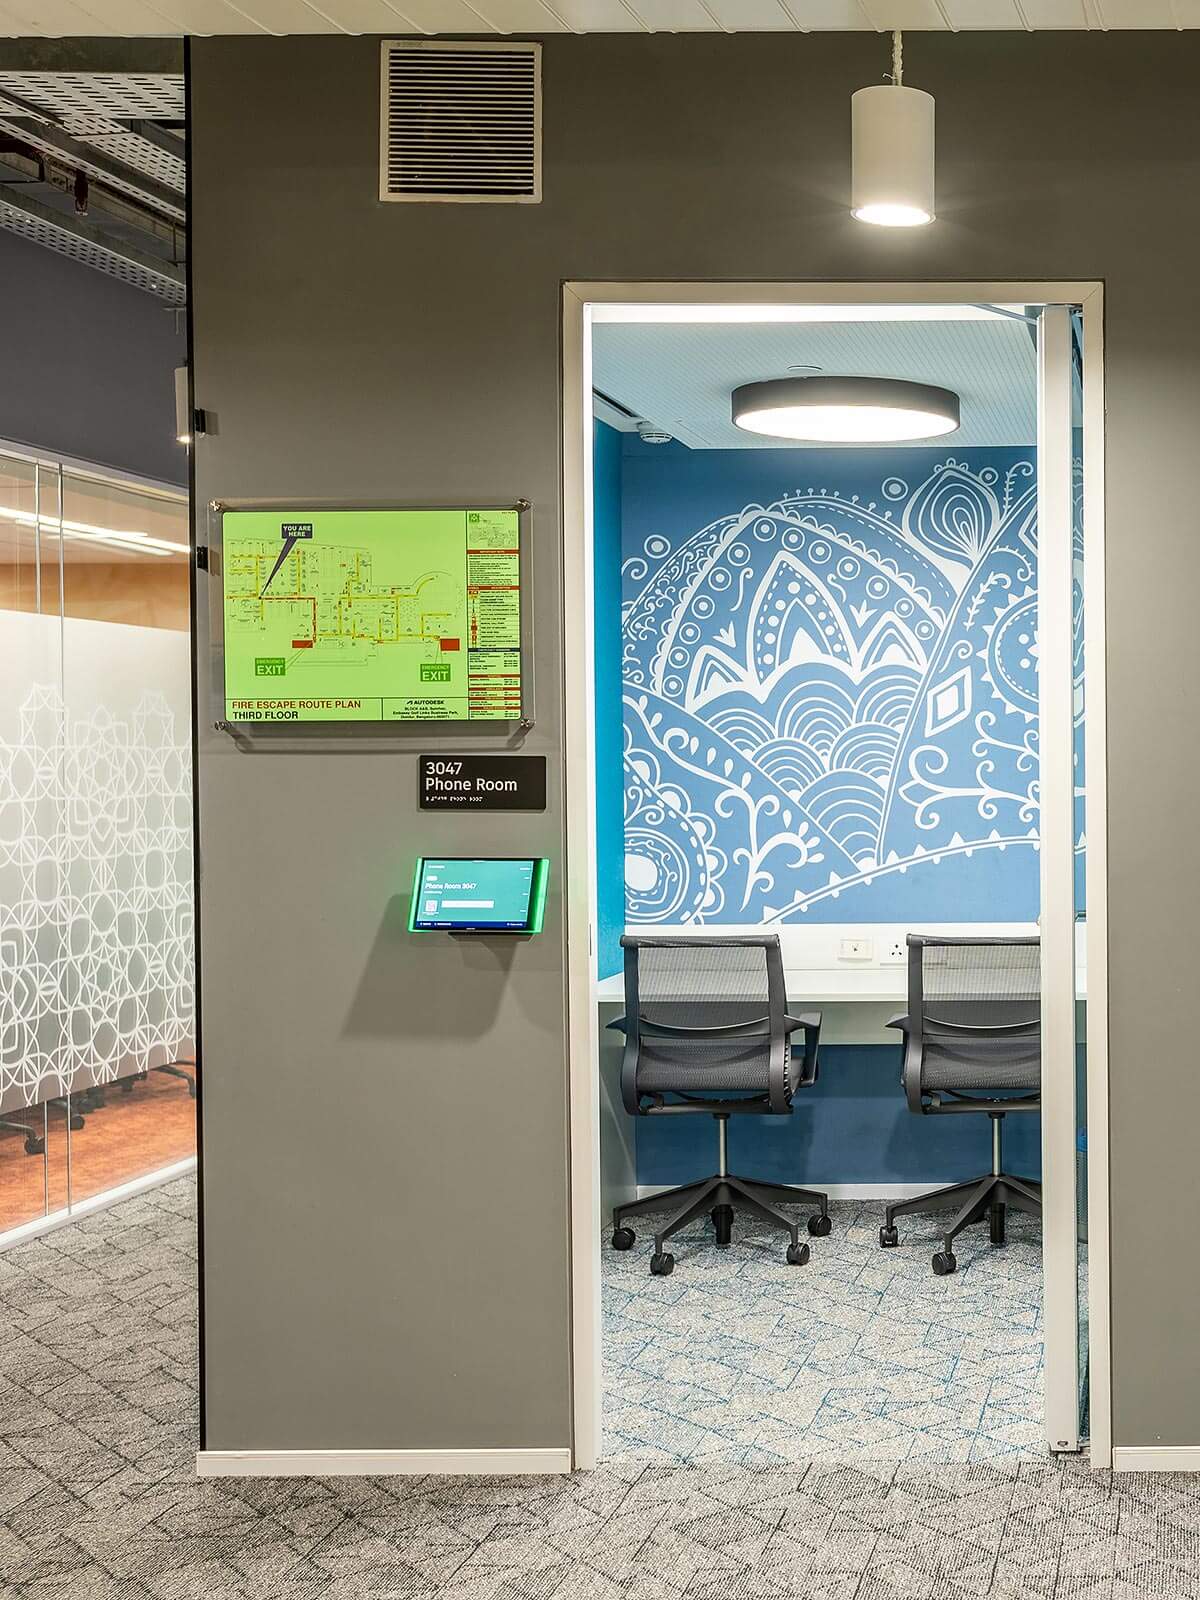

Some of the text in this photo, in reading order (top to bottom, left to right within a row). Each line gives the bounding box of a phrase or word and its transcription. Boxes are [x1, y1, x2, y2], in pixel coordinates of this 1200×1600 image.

[257, 665, 283, 674] EXIT
[422, 671, 449, 680] EXIT
[232, 700, 361, 709] FIRE ESCAPE ROUTE PLAN
[232, 711, 299, 719] THIRD FLOOR
[426, 761, 463, 775] 3047
[425, 777, 518, 791] Phone Room
